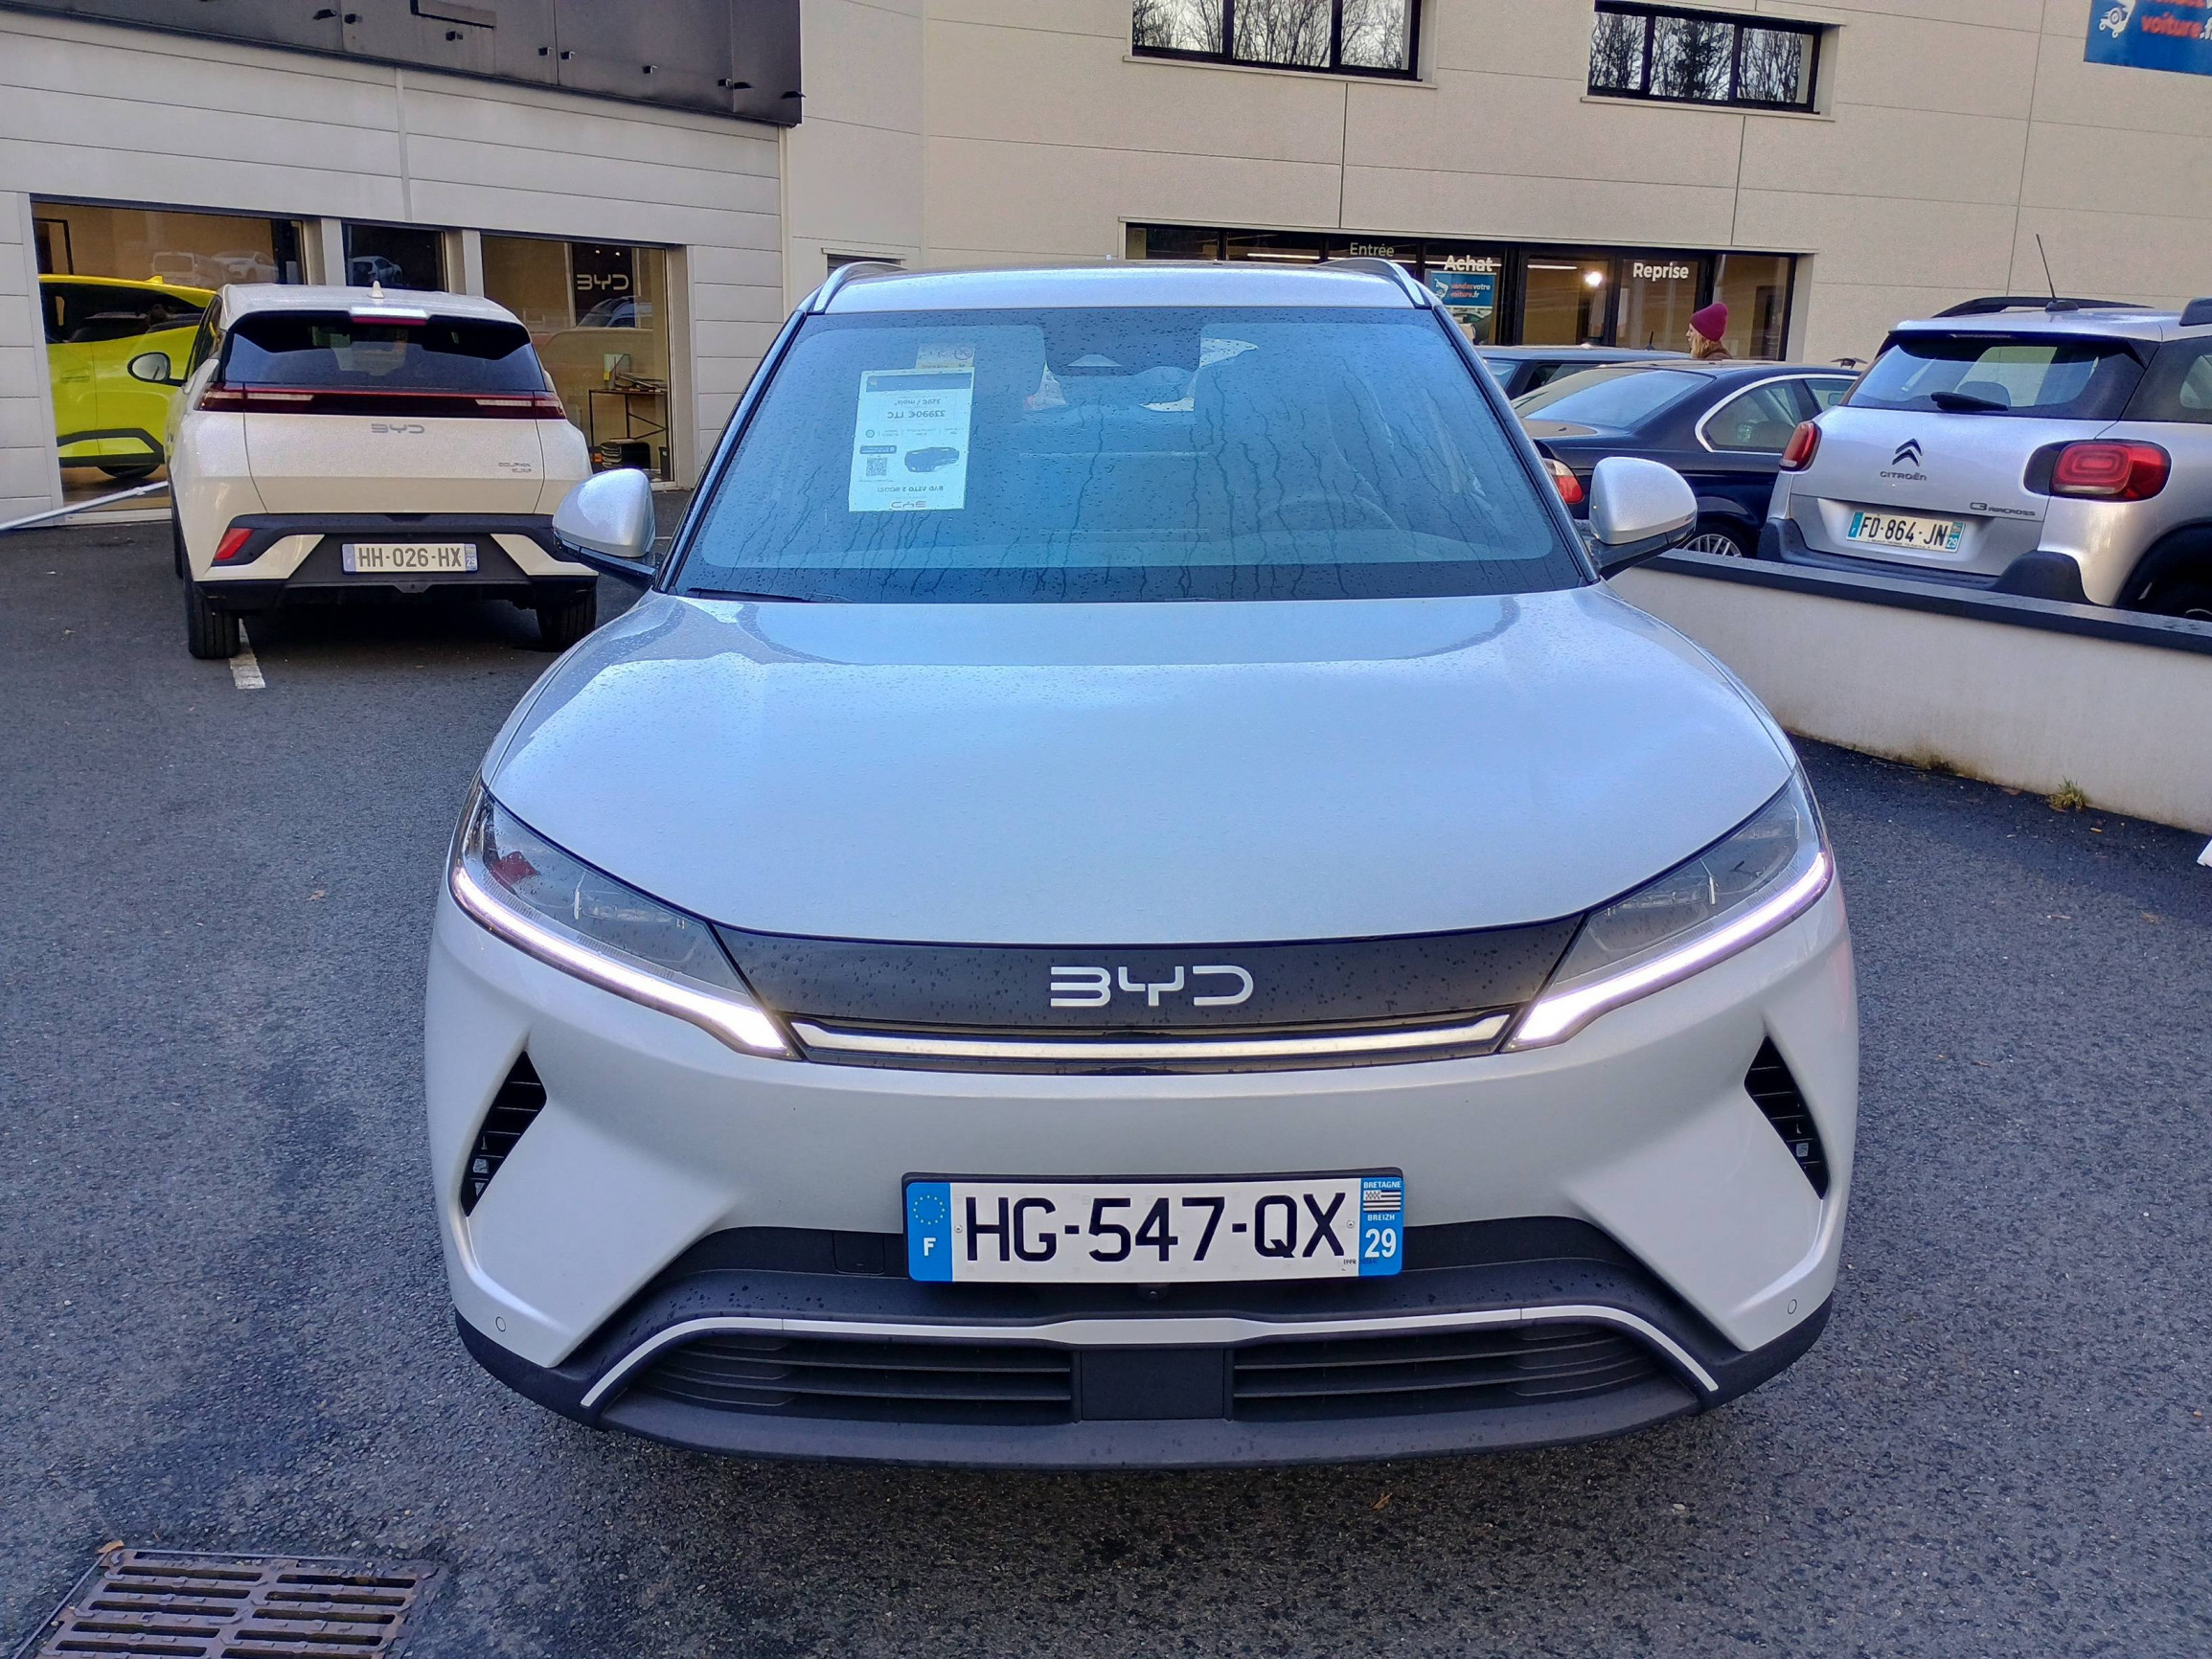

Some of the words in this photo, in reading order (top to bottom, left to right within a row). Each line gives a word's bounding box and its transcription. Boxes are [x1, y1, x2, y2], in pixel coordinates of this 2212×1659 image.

[1350, 242, 1395, 258] Entrée
[1444, 255, 1494, 272] Achat
[1632, 261, 1689, 282] Reprise
[577, 274, 629, 290] BYD
[371, 423, 424, 434] BYD
[1947, 536, 1958, 548] 29
[358, 547, 462, 568] HH-026-HX
[466, 557, 476, 567] 29
[1050, 965, 1254, 1007] BYD
[1363, 1180, 1402, 1189] BRETAGNE
[966, 1193, 1346, 1262] HG-547-QX
[924, 1238, 937, 1257] F
[1364, 1228, 1397, 1258] 29
